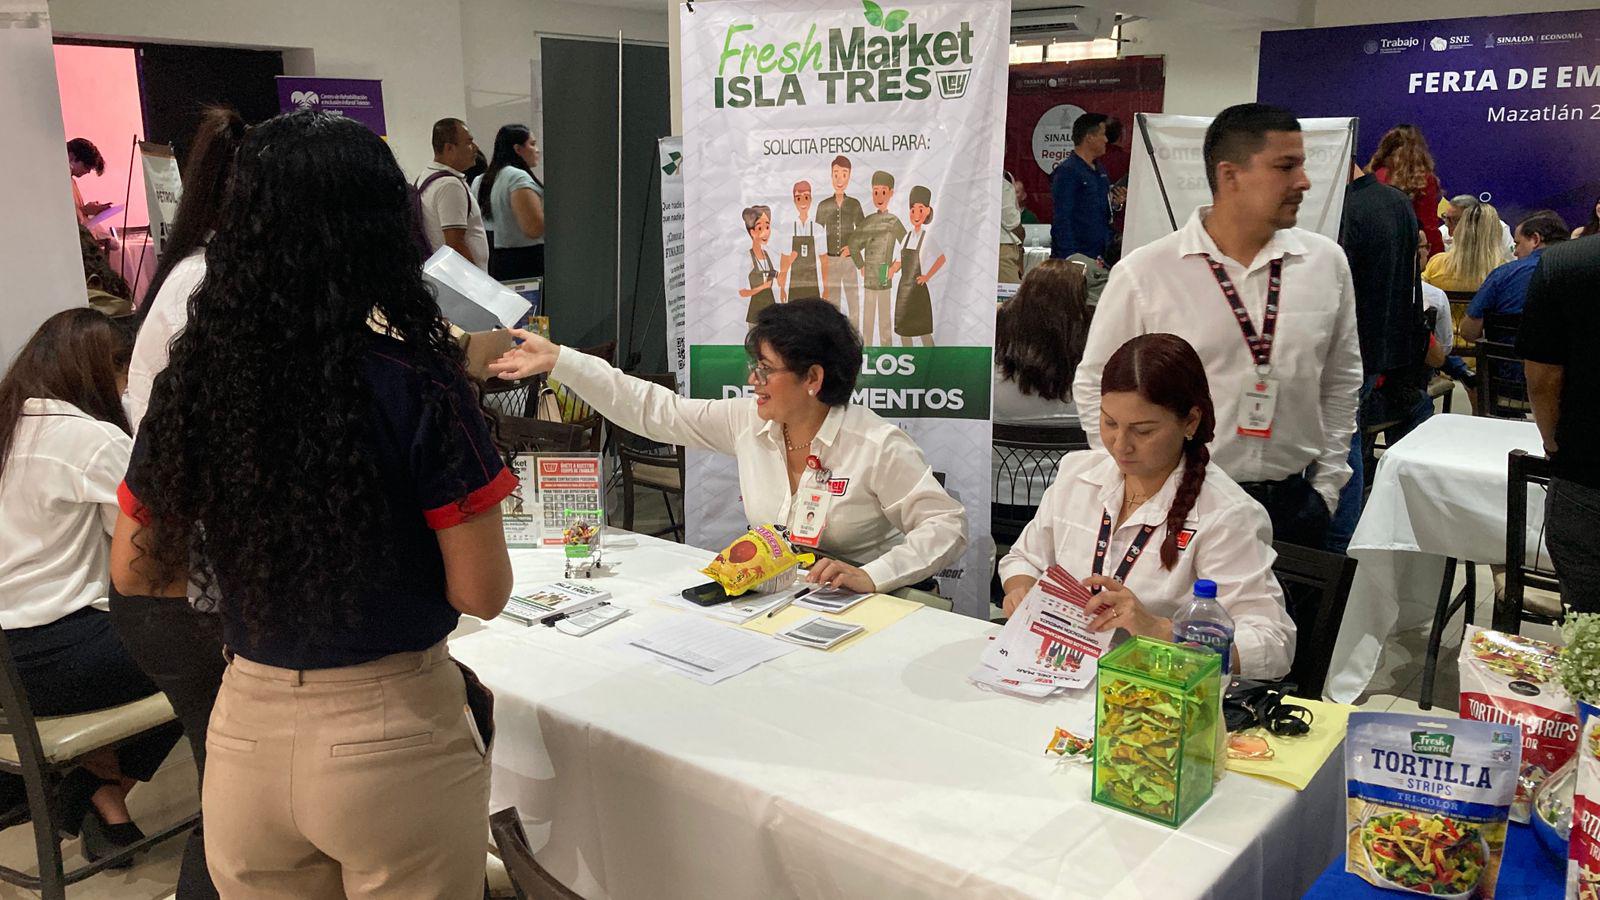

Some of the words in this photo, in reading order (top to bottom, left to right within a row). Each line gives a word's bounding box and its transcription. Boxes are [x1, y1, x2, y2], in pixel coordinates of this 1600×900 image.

[1381, 38, 1419, 48] Trabajo
[1450, 35, 1470, 44] SNE
[1497, 35, 1534, 44] SINALOA
[1541, 32, 1583, 41] ECONOMÍA
[718, 23, 823, 76] Fresh
[829, 21, 974, 72] Market
[714, 74, 806, 109] ISLA
[818, 67, 932, 104] TRES
[1409, 69, 1498, 94] FERIA
[1507, 67, 1548, 90] DE
[1488, 104, 1583, 122] Mazatlán
[763, 138, 817, 156] SOLICITA
[820, 135, 889, 154] PERSONAL
[892, 133, 931, 151] PARA:
[1044, 133, 1072, 143] SINAL
[1041, 149, 1073, 161] Regis
[861, 353, 915, 375] LOS
[722, 384, 965, 410] DEMENTOS
[1468, 698, 1522, 728] TORTILLA
[1524, 715, 1579, 742] STRIPS
[1412, 743, 1451, 754] Gourmet
[1419, 734, 1446, 746] Fresh
[1370, 748, 1493, 789] TORTILLA
[1407, 778, 1452, 796] STRIPS
[1397, 791, 1459, 811] TRI-COLOR
